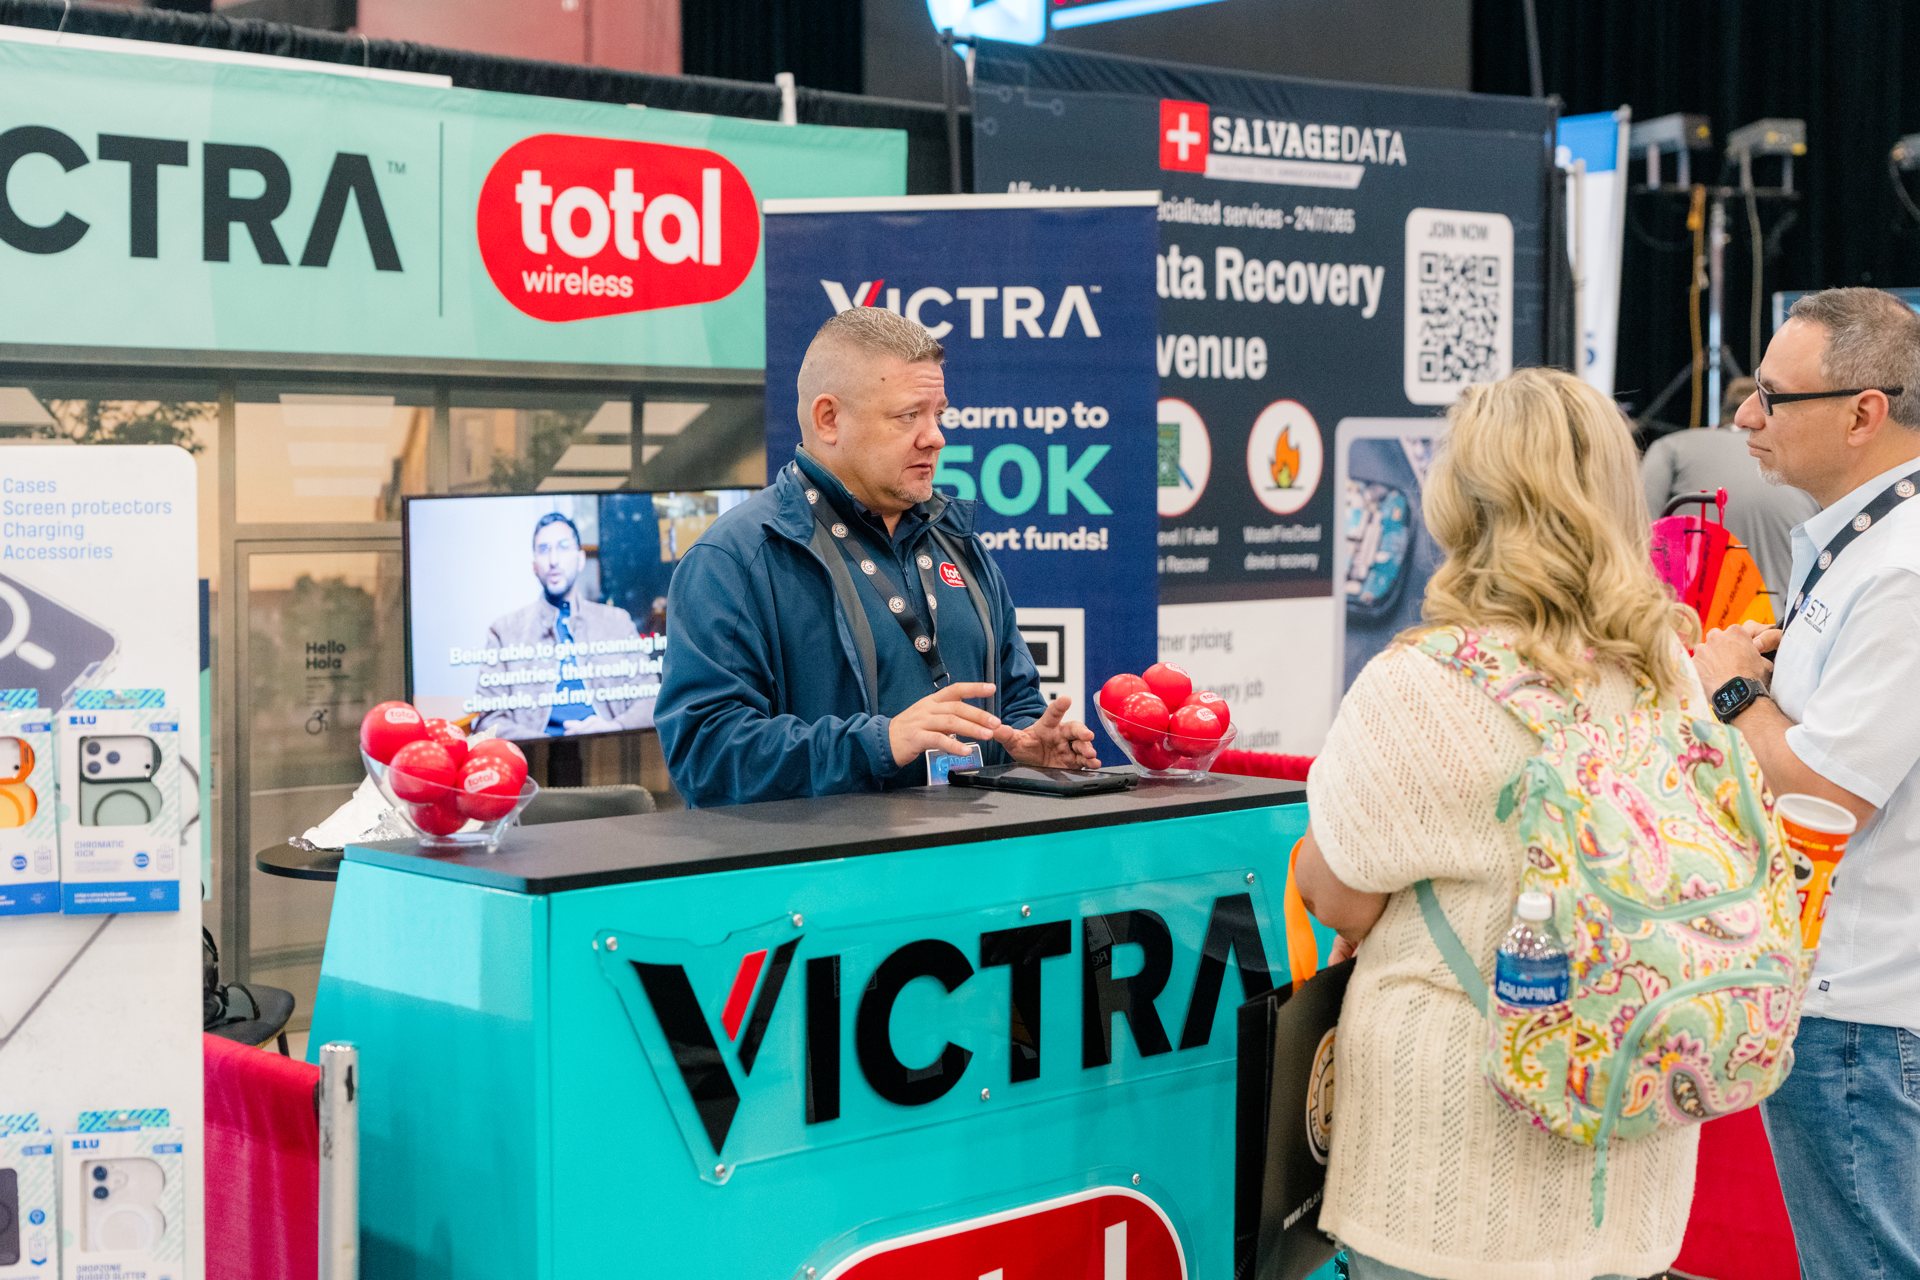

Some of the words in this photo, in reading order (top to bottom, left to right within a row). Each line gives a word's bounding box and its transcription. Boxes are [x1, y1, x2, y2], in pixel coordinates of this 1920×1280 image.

[1212, 116, 1408, 167] SALVAGEDATA
[515, 167, 722, 267] total
[1223, 203, 1283, 230] services
[522, 267, 634, 299] wireless
[1216, 246, 1385, 319] Recovery
[941, 406, 1017, 429] earn
[1023, 406, 1068, 434] up
[1072, 401, 1109, 429] to
[3, 478, 57, 494] Cases
[3, 500, 66, 516] Screen
[71, 499, 173, 519] protectors
[3, 521, 85, 541] Charging
[1024, 526, 1109, 551] funds!
[3, 543, 114, 560] Accessories
[1806, 599, 1832, 627] STX
[306, 640, 346, 655] Hello
[449, 647, 498, 666] Being
[499, 643, 535, 662] able
[535, 643, 556, 659] to
[554, 639, 588, 661] give
[589, 636, 654, 655] roaming
[1189, 627, 1234, 655] pricing
[306, 657, 342, 670] Hola
[562, 662, 595, 681] that
[595, 659, 638, 679] really
[538, 687, 569, 707] and
[570, 688, 594, 706] my
[69, 716, 96, 725] BLU
[74, 840, 125, 849] CHROMATIC
[74, 850, 95, 858] KICK
[1498, 979, 1557, 1002] AQUAFINA
[630, 892, 1280, 1156] VICTRA
[71, 1139, 100, 1150] BLU
